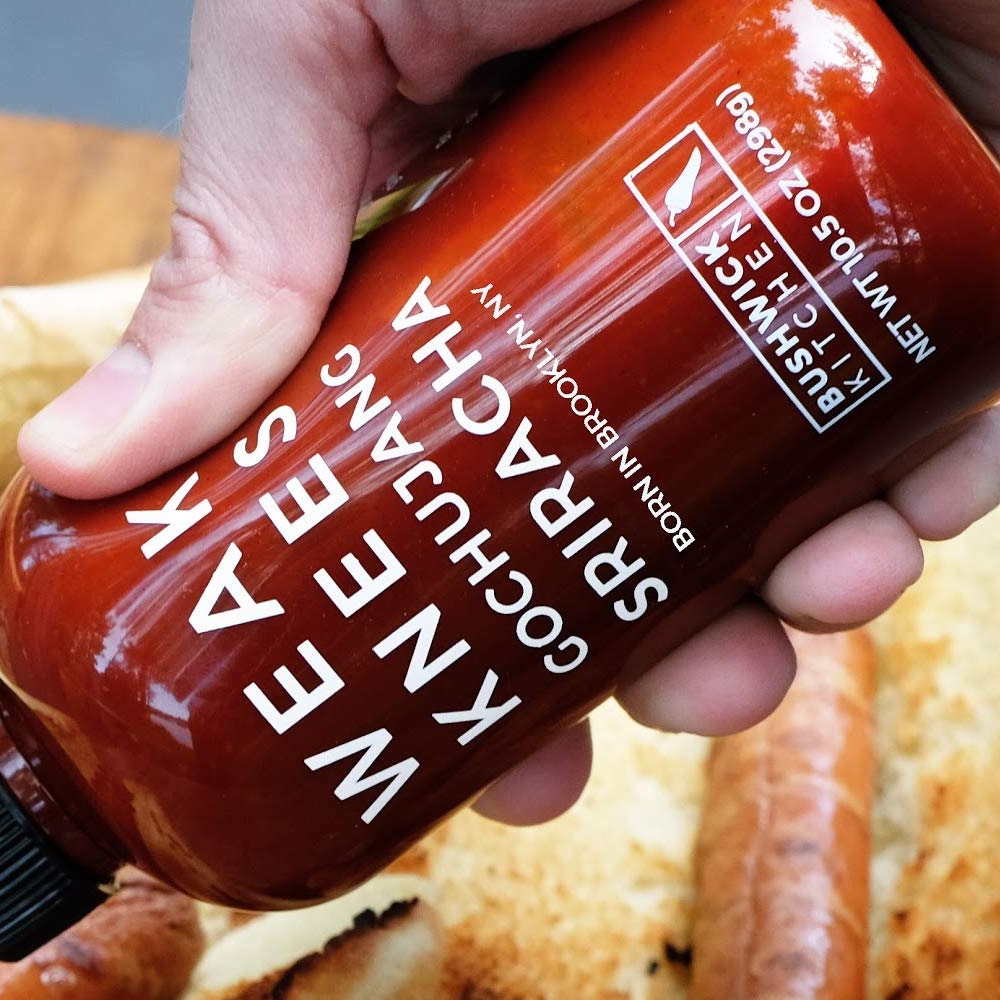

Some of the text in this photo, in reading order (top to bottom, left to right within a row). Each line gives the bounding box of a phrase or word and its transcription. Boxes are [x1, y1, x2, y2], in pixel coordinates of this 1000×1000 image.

[695, 230, 846, 414] BUSHWICK
[715, 83, 937, 364] NET WT 10.5 OZ (298g)
[720, 212, 871, 394] KITCHEN
[320, 344, 588, 674] GOCHUJANG
[392, 275, 669, 622] SRIRACHA
[471, 283, 695, 552] BORN IN BROOKLYN, NY
[125, 472, 420, 824] WEAK
[233, 404, 522, 746] KNEES
